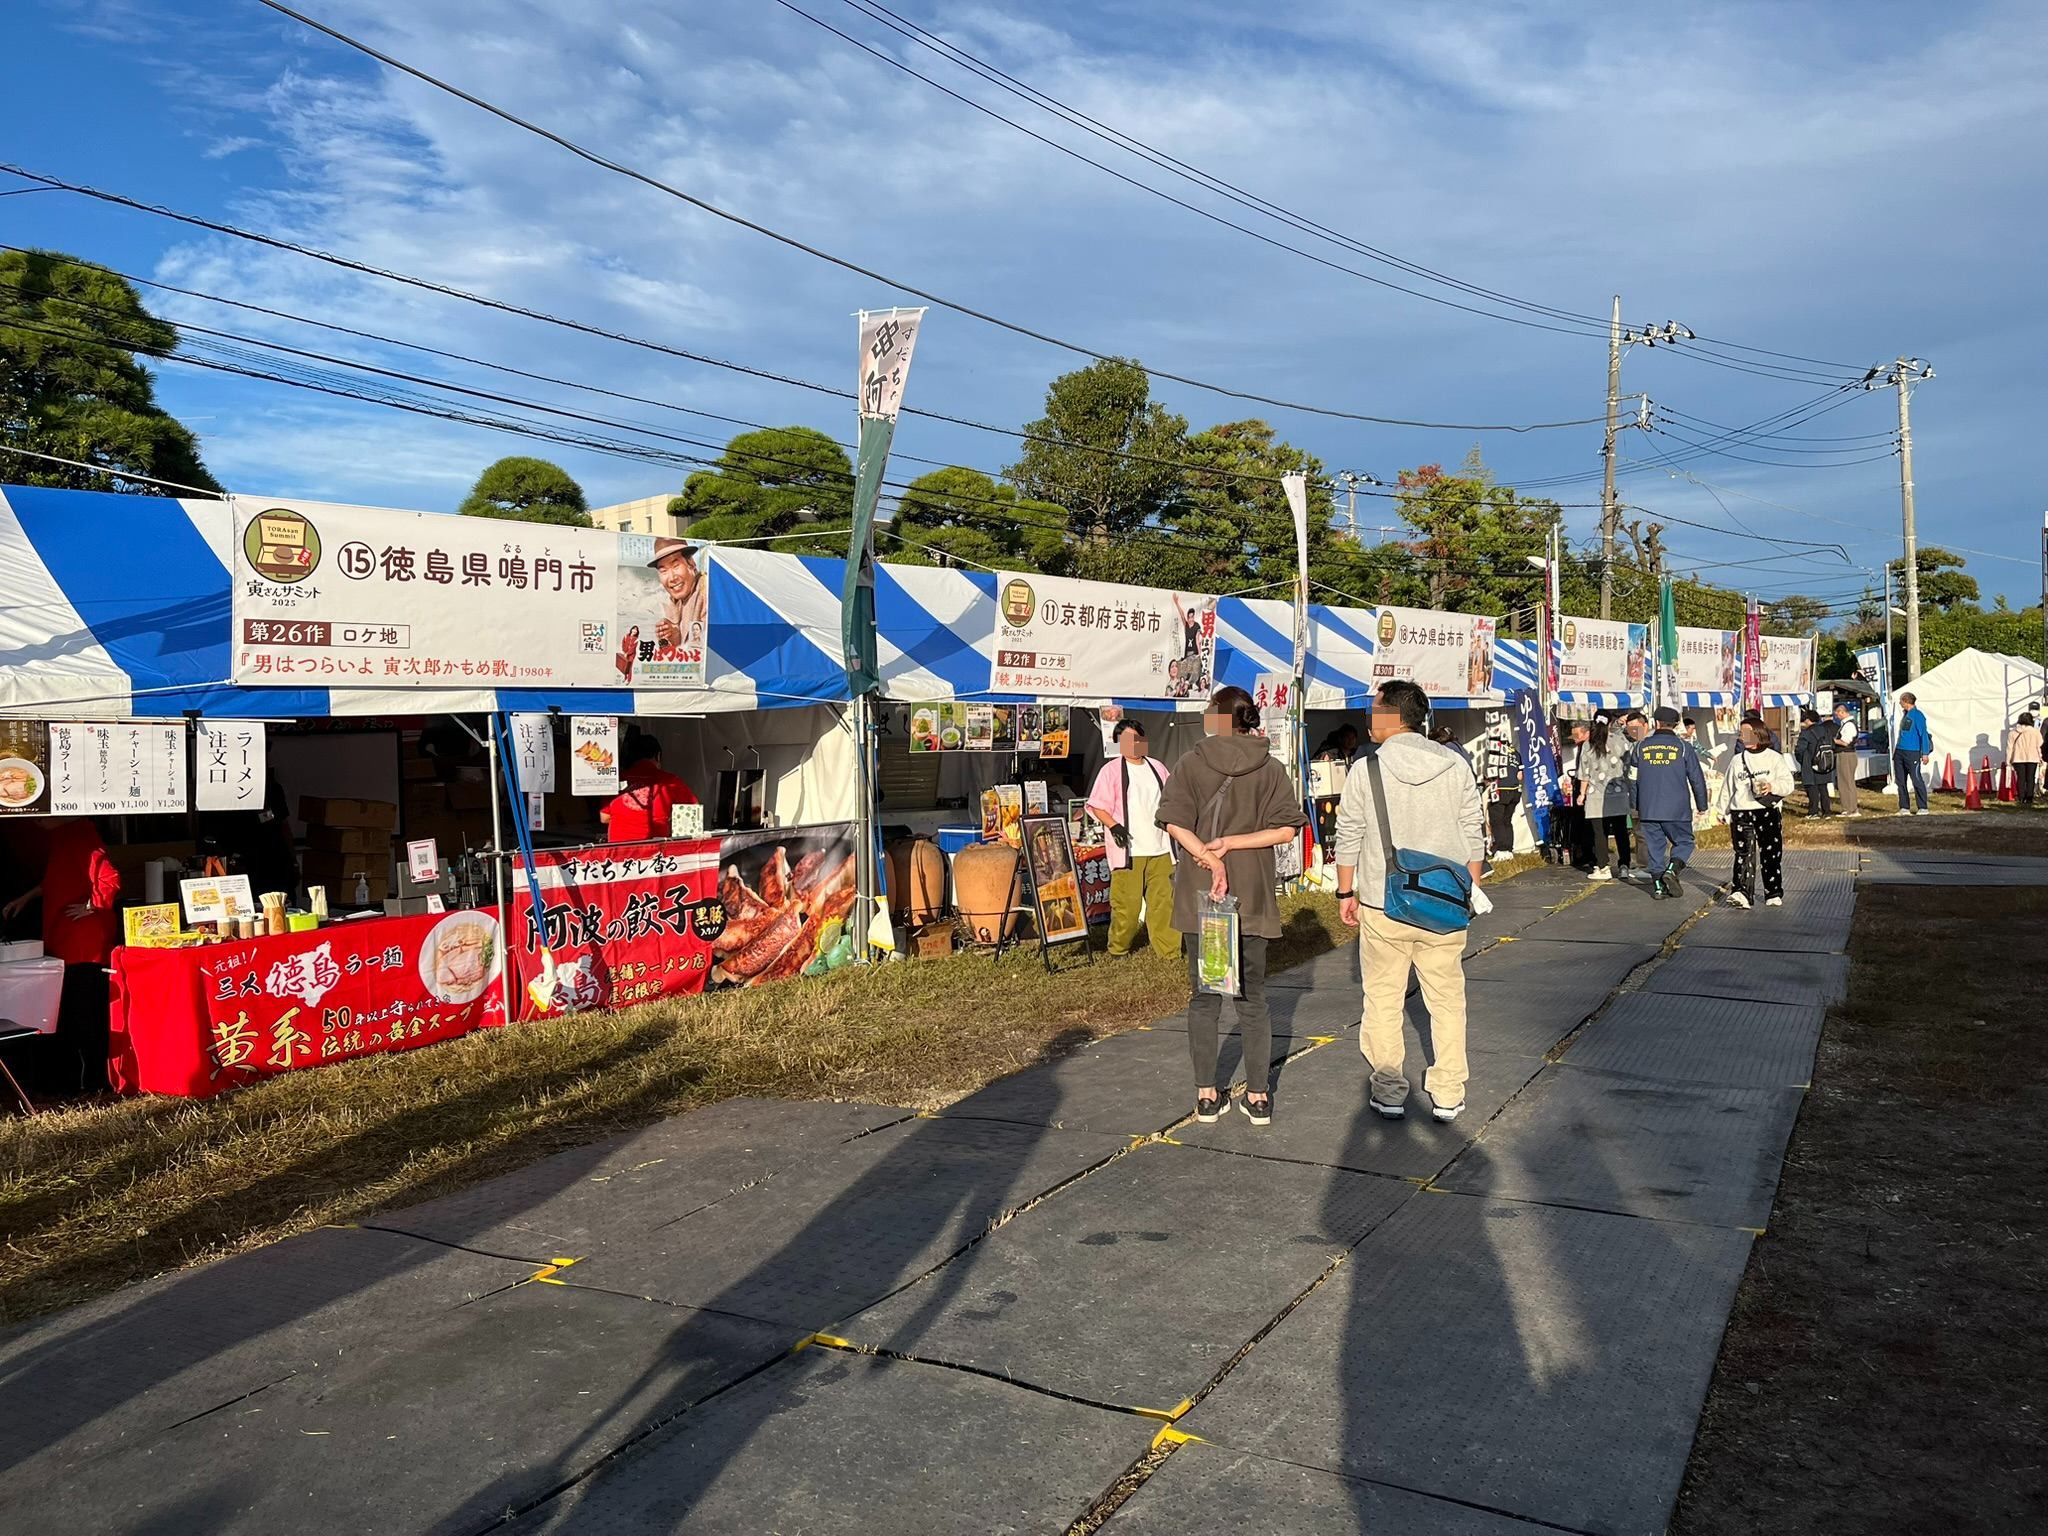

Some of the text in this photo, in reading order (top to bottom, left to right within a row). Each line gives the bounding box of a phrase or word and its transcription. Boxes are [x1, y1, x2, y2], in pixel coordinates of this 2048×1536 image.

[267, 526, 299, 534] TORAsan
[270, 532, 296, 540] Summit
[246, 579, 321, 599] 寅さんサミット
[272, 598, 296, 607] 2025
[249, 621, 325, 644] 第26作
[343, 627, 398, 645] ロケ地
[638, 640, 702, 663] 男はつらいよ
[1003, 652, 1030, 666] 第2作
[1040, 656, 1066, 667] ロケ地
[1255, 682, 1288, 710] 京都
[209, 730, 227, 784] 注文口
[520, 724, 535, 769] 注文口
[538, 724, 549, 784] ギョーザ
[59, 728, 72, 793] 徳島ラーメン
[128, 730, 141, 798] チャーシュー麺
[165, 730, 177, 796] 味玉チャーシュー麺
[237, 732, 254, 801] ラーメン
[597, 766, 617, 776] 500円
[55, 802, 78, 811] ¥800
[93, 802, 116, 810] ¥900
[121, 800, 149, 808] ¥1,100
[157, 799, 185, 808] ¥1,200
[560, 852, 679, 882] すだちダレ香る
[694, 905, 725, 926] 黒豚
[271, 952, 340, 997] 徳島
[606, 952, 707, 984] 老舗ラーメン店
[608, 980, 664, 1006] 屋台限定
